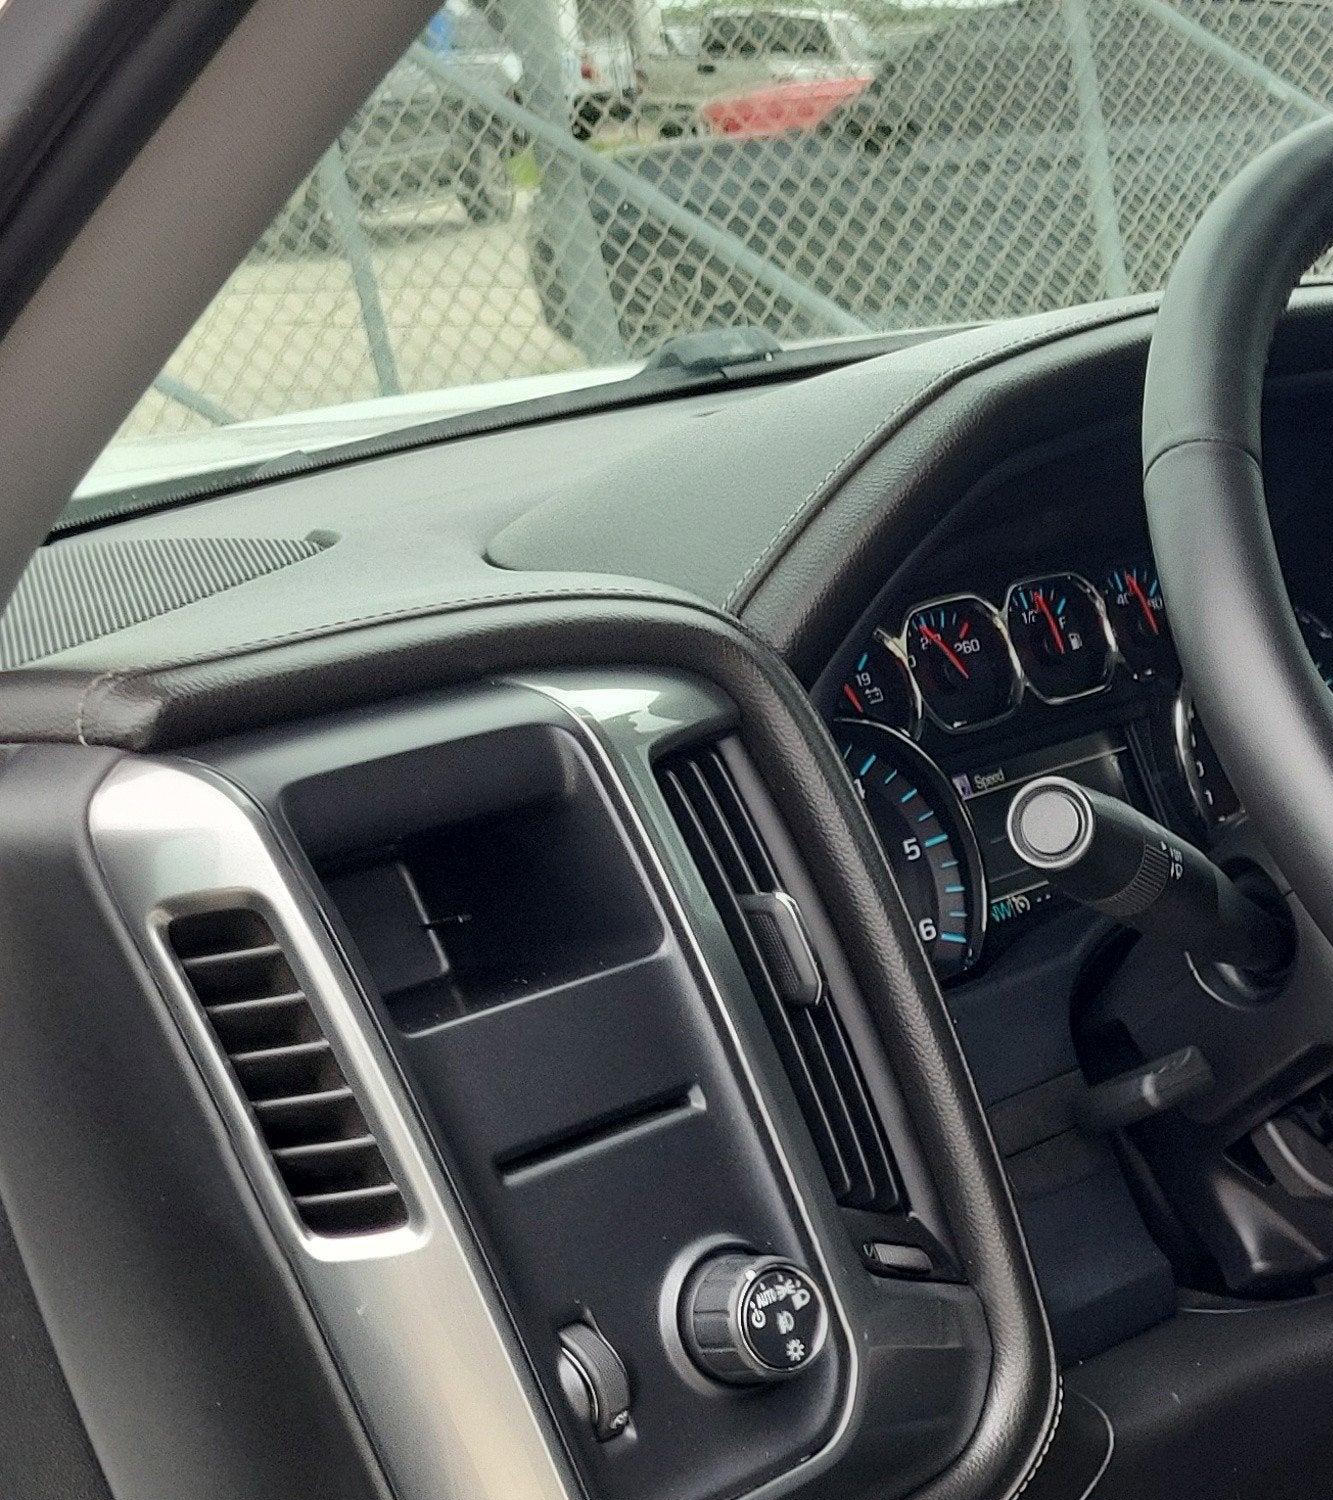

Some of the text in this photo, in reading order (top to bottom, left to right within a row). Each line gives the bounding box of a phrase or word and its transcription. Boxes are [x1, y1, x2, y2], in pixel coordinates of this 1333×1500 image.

[855, 671, 872, 688] 19
[973, 768, 1006, 793] Speed
[902, 837, 922, 861] 5
[918, 917, 937, 941] 6
